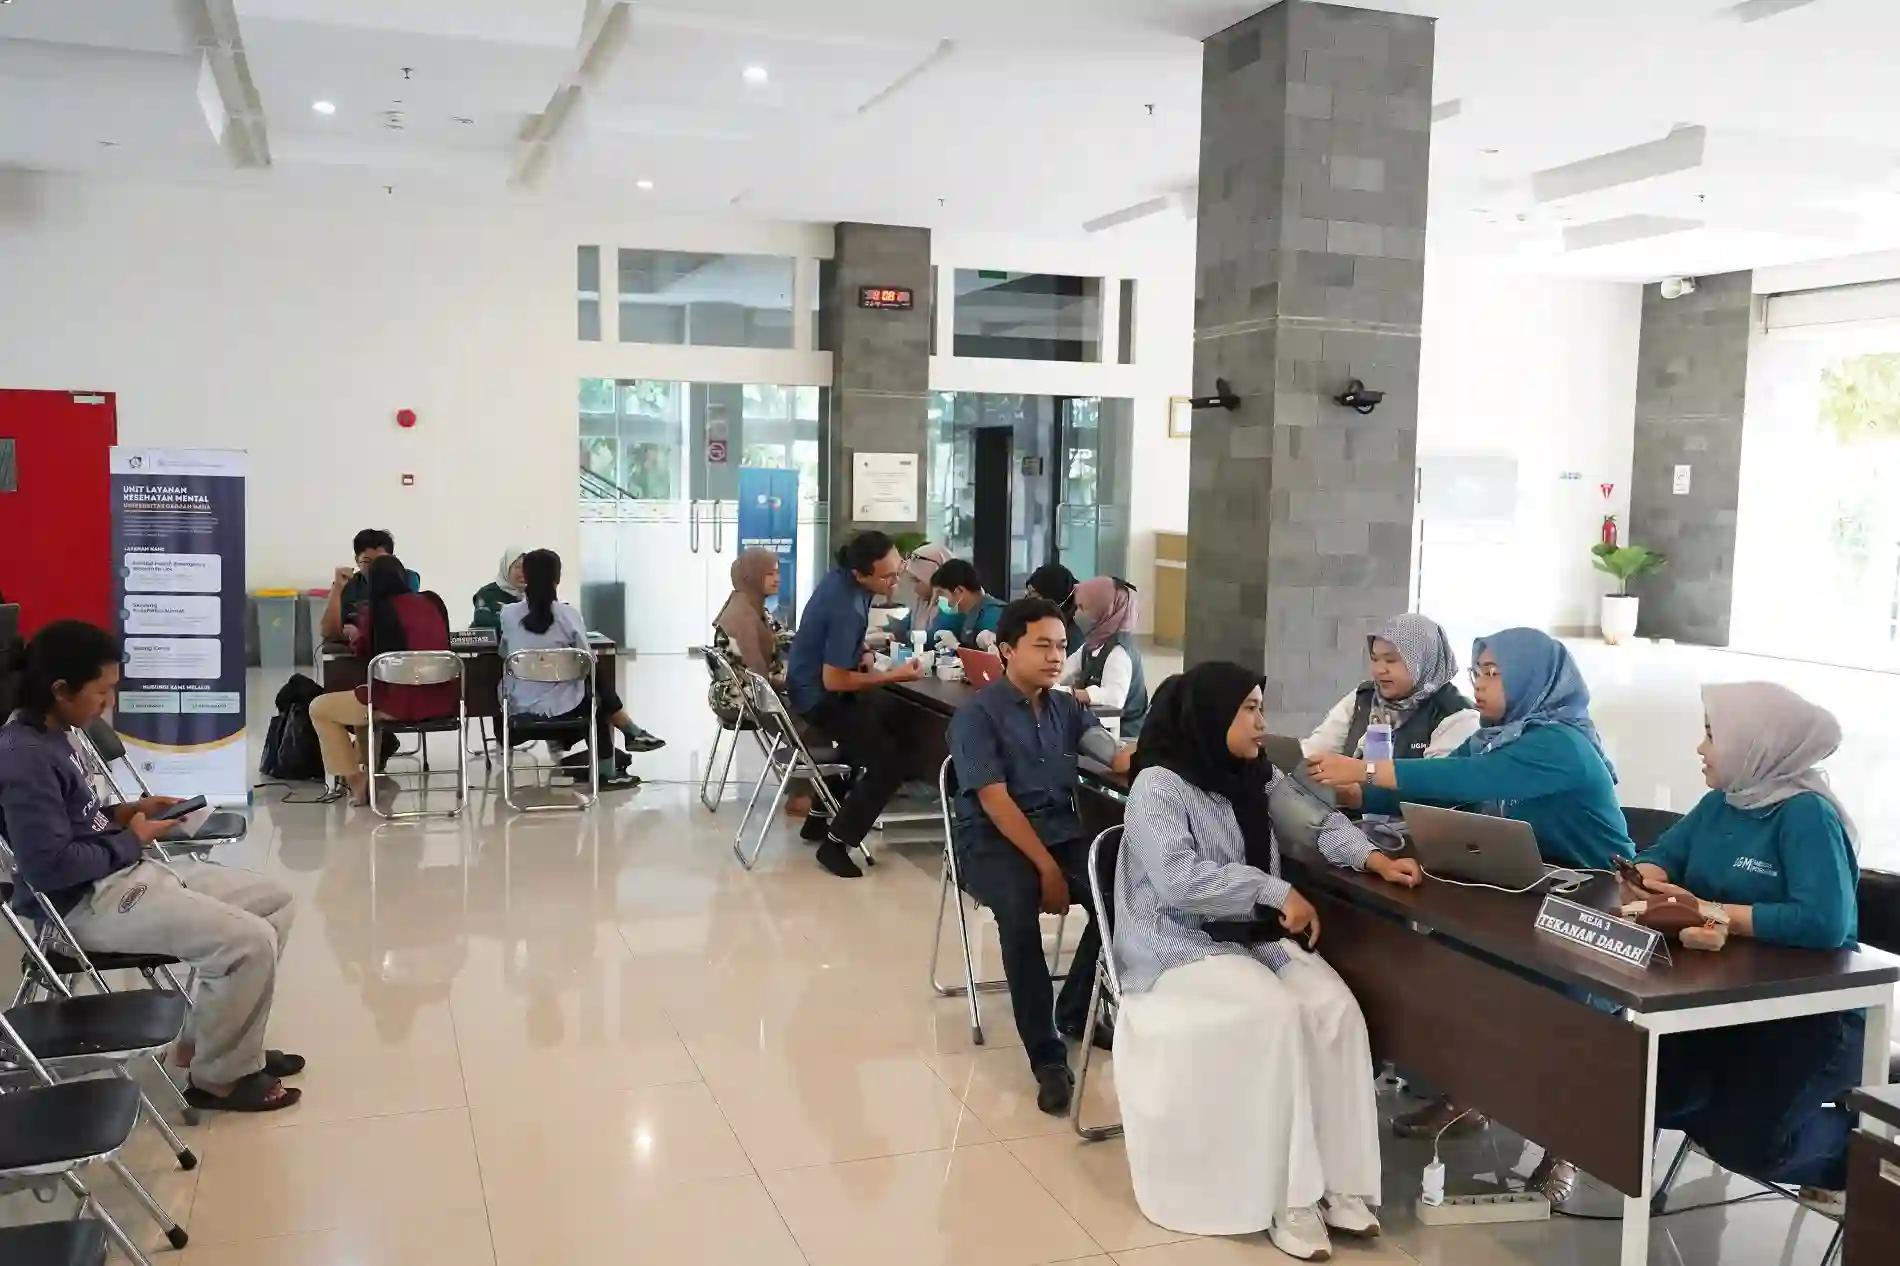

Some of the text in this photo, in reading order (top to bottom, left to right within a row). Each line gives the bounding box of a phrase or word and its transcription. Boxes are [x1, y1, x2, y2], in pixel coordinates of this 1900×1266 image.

[123, 485, 187, 494] UNIT LAYANAN
[123, 494, 209, 503] KESEHATAN MENTAL
[1578, 912, 1610, 931] MEJA 3
[1539, 915, 1644, 962] TEKANAN DARAH
